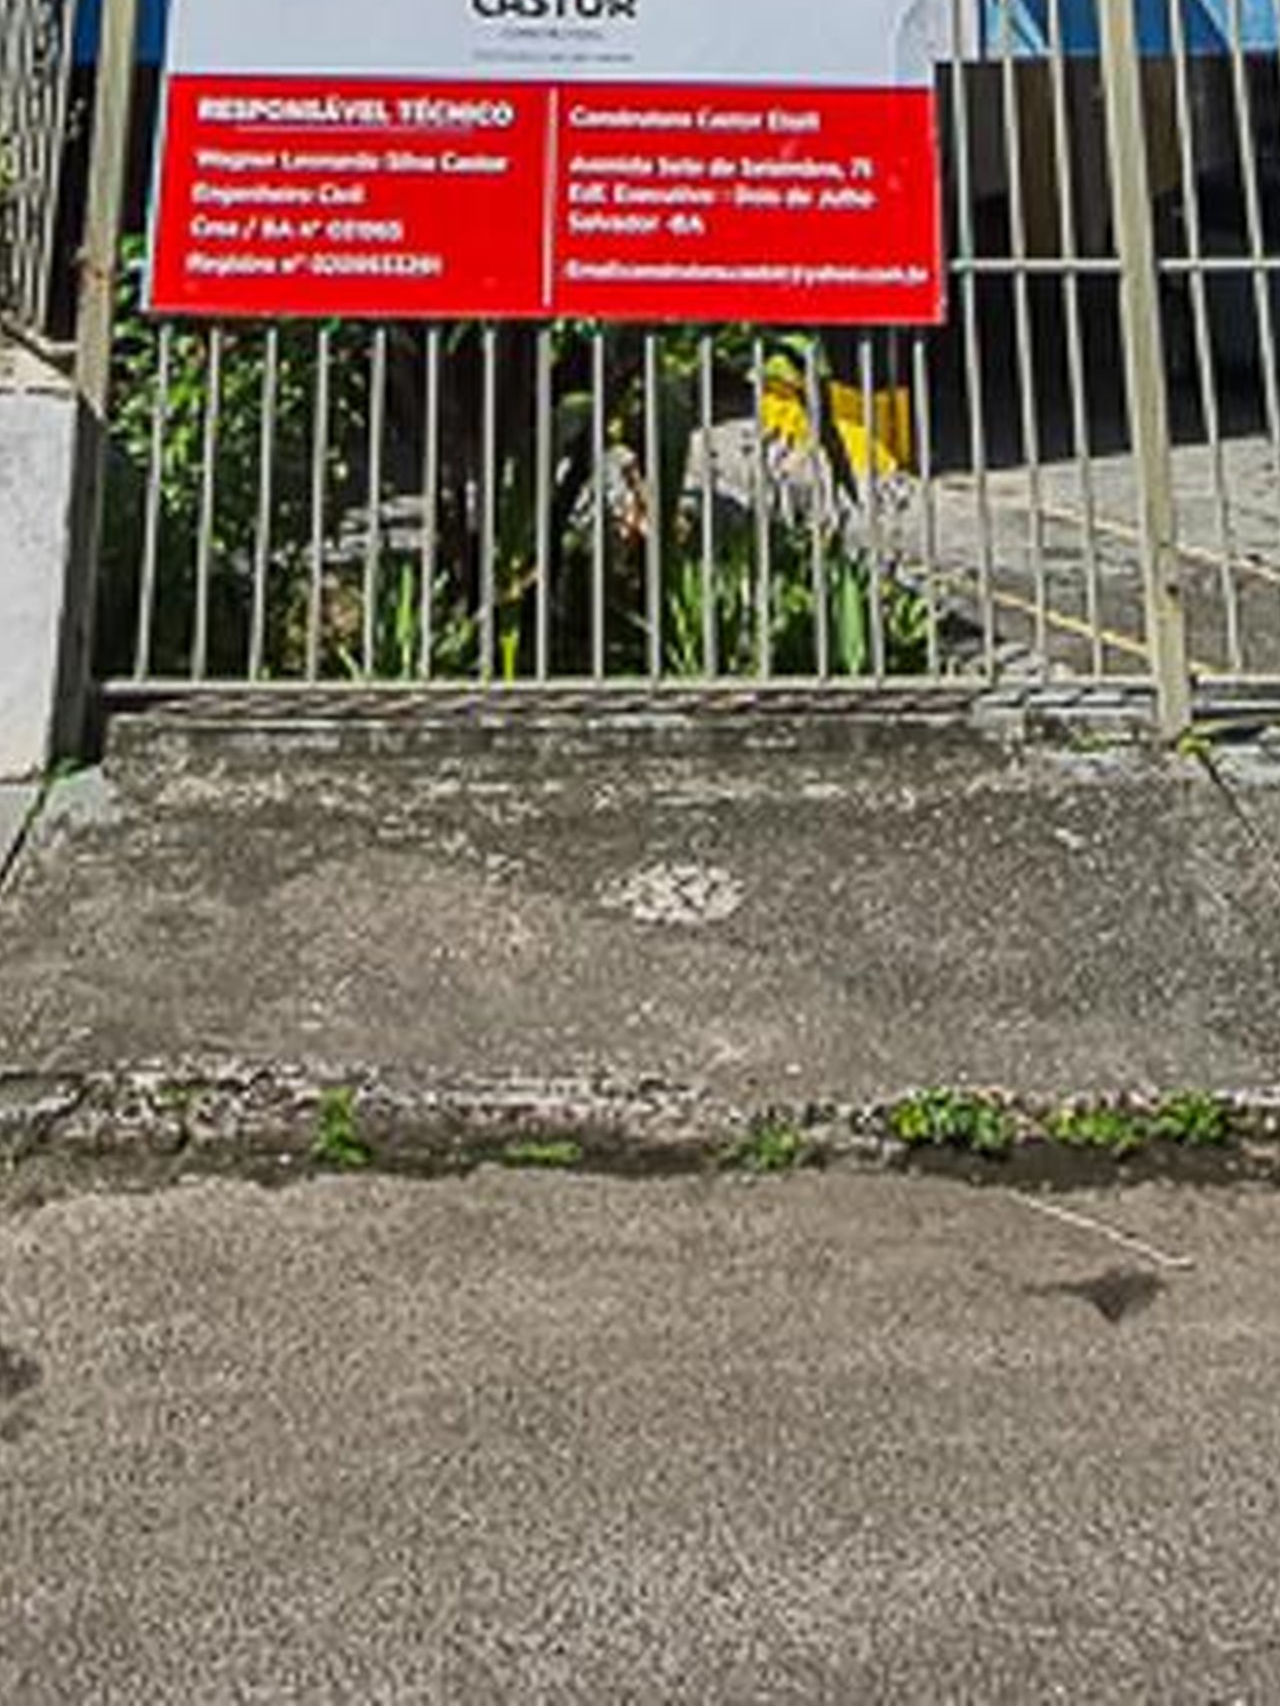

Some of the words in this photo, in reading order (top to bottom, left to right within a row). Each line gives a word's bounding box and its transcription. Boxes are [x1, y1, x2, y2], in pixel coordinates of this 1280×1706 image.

[198, 94, 392, 121] RESPONSÁVEL
[398, 99, 514, 128] TÉCNICO
[697, 107, 762, 129] Castor
[440, 153, 508, 173] Castor
[709, 158, 738, 179] de
[192, 183, 315, 205] Engenheiro
[320, 184, 366, 204] Civil
[568, 210, 660, 233] Salvador
